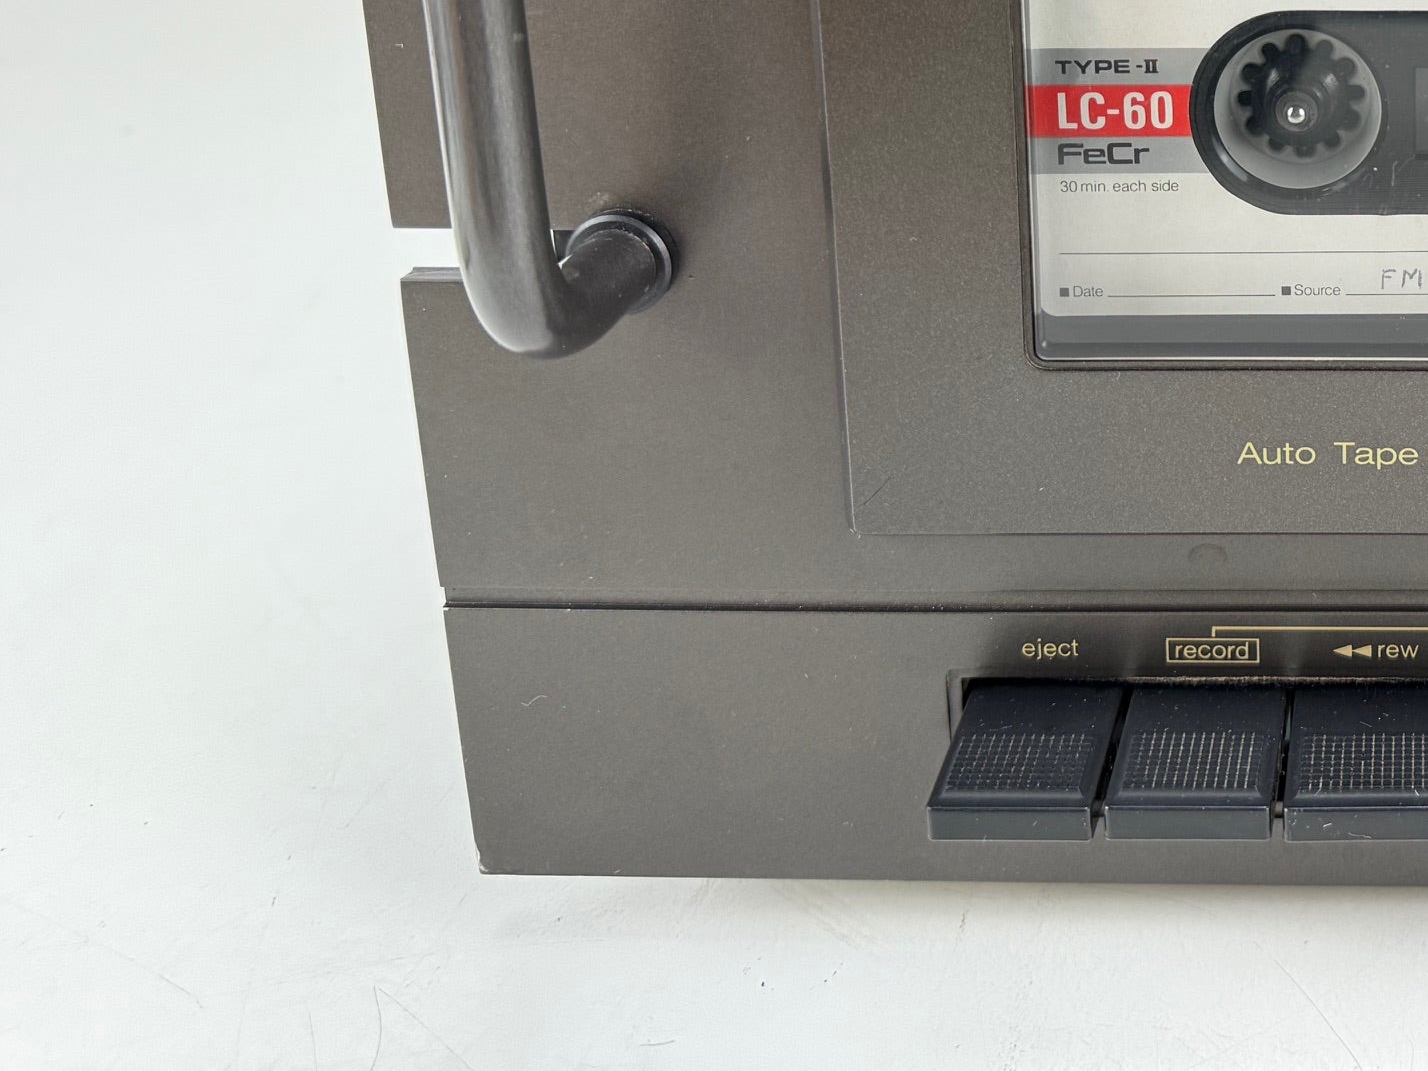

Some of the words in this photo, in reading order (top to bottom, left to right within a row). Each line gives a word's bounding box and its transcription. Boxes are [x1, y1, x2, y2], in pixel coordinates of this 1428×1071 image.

[1056, 90, 1174, 130] LC-60
[1056, 142, 1150, 166] FeCr
[1112, 179, 1147, 193] each
[1151, 179, 1179, 192] side
[1380, 267, 1424, 290] FM
[1072, 284, 1104, 298] Date
[1293, 283, 1342, 298] Source
[1236, 441, 1317, 466] Auto
[1333, 441, 1420, 471] Tape
[1020, 638, 1080, 662] eject
[1174, 640, 1251, 661] record
[1377, 642, 1420, 659] rew
